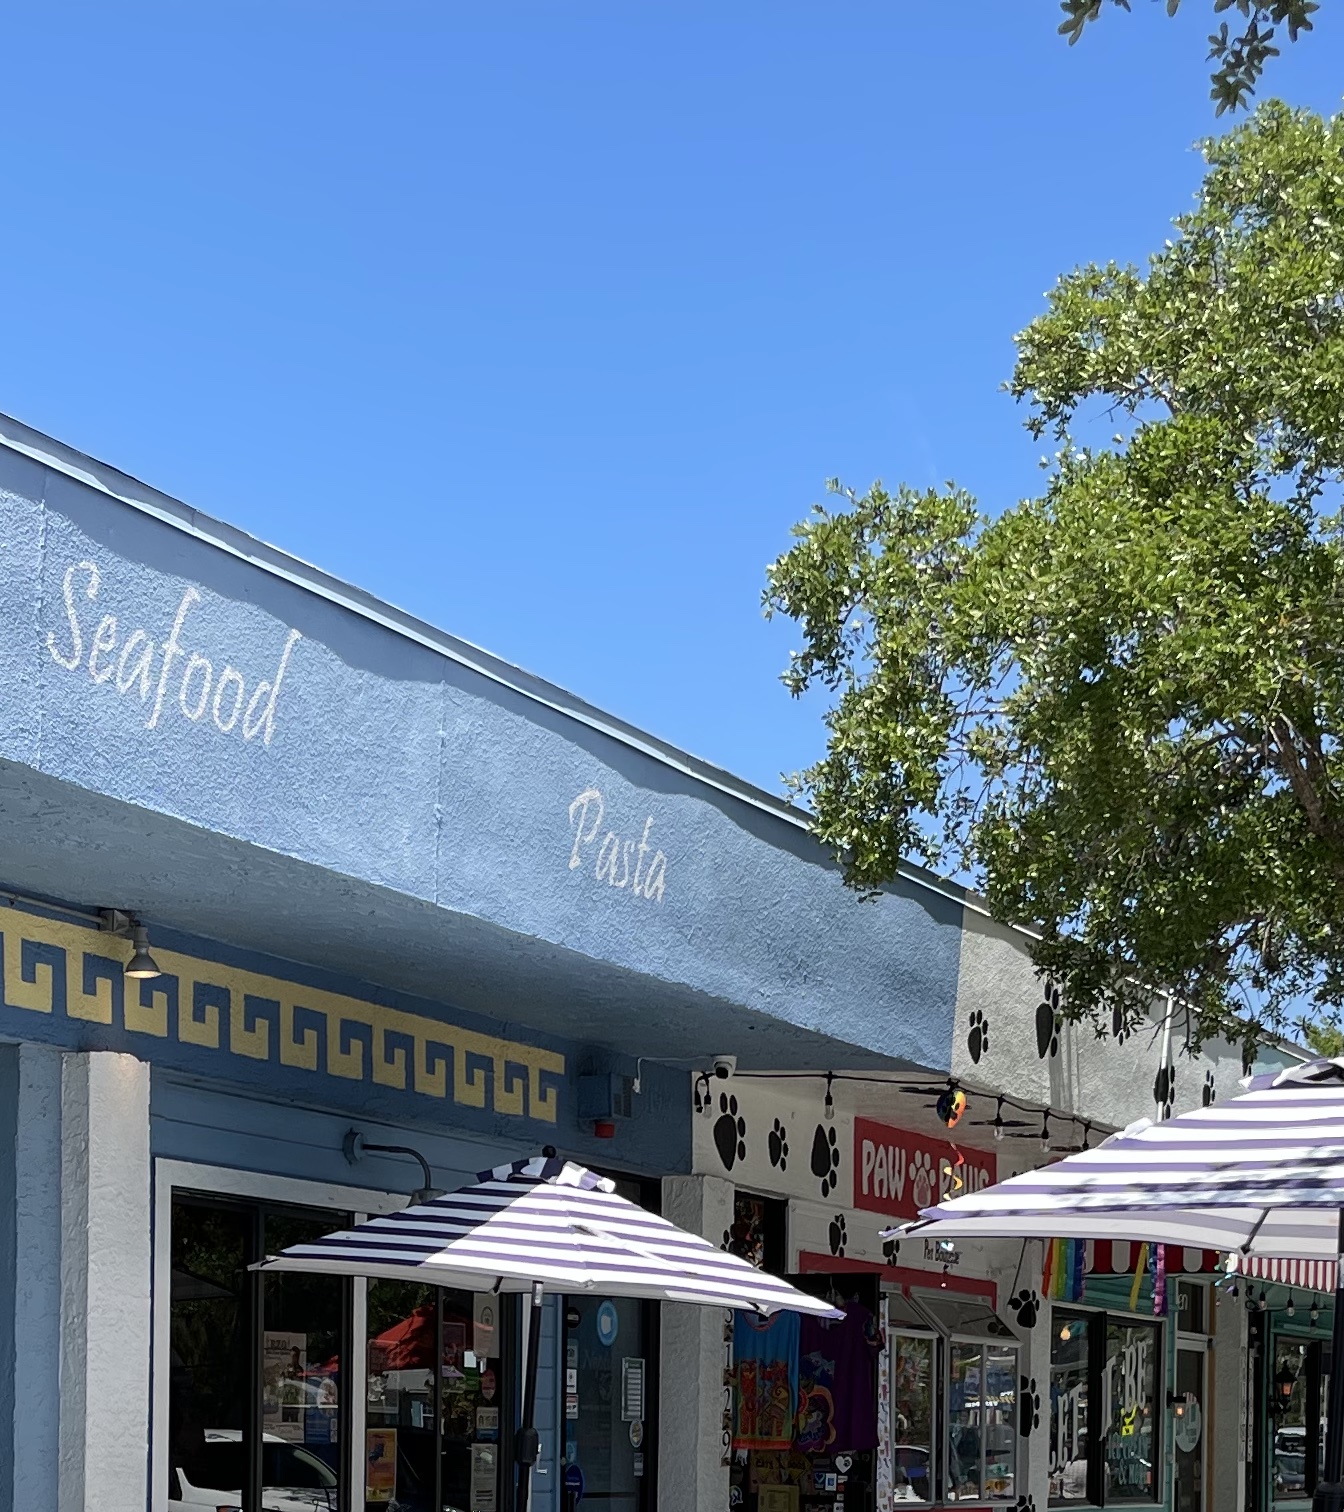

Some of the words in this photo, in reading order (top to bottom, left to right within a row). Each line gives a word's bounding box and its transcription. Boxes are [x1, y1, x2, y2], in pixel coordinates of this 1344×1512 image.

[46, 559, 302, 747] Seafood
[568, 786, 667, 903] Pasta
[862, 1139, 906, 1202] PAW
